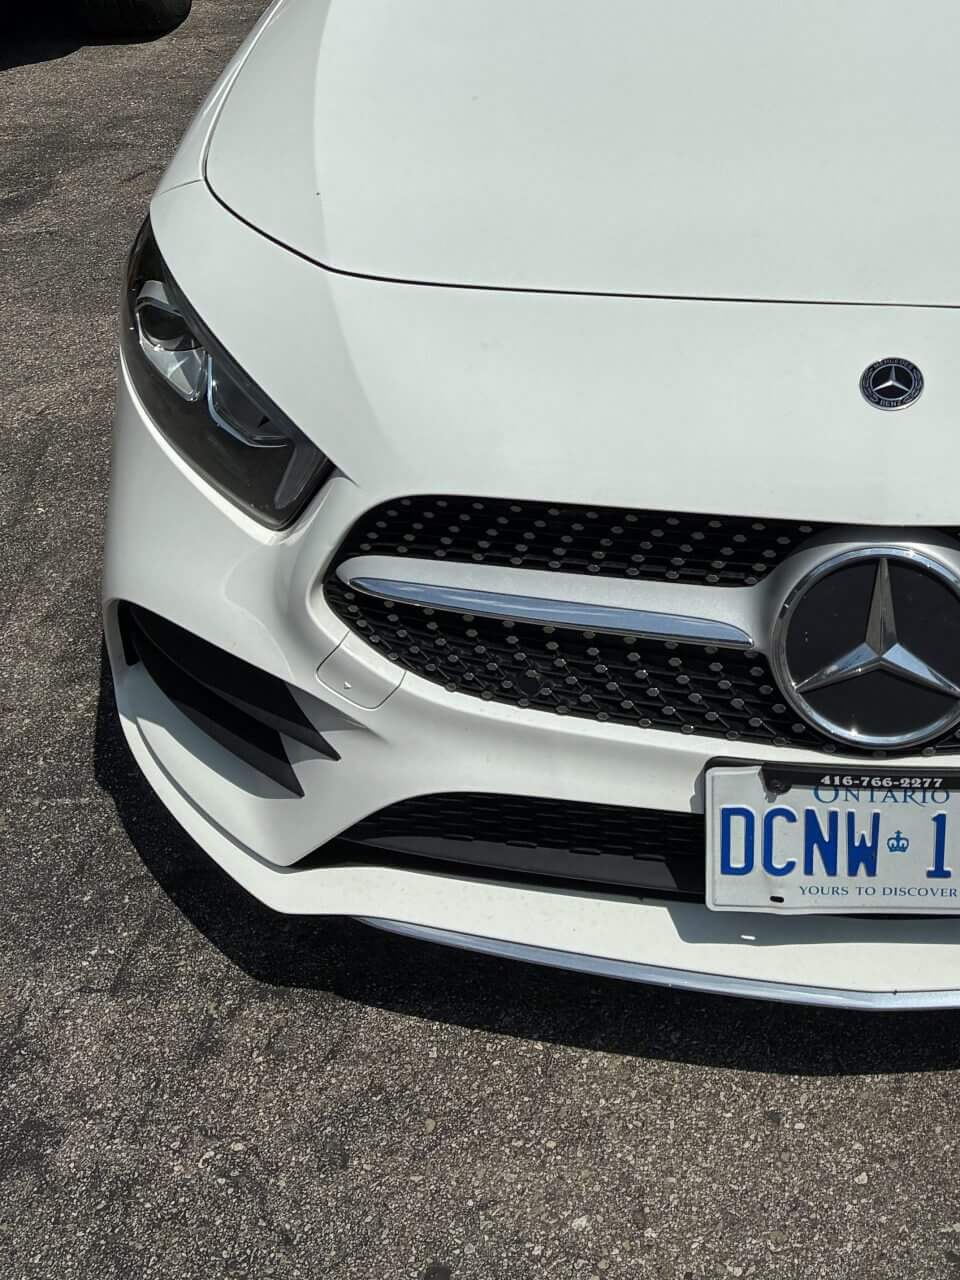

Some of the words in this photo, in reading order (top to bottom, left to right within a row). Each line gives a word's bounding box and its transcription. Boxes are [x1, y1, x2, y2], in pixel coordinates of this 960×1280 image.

[820, 775, 943, 788] 416-766-2277
[813, 786, 950, 807] ONTARIO
[720, 806, 881, 877] DCNW
[799, 885, 849, 896] YOURS
[855, 886, 876, 896] TO
[882, 886, 958, 897] DISCOVER
